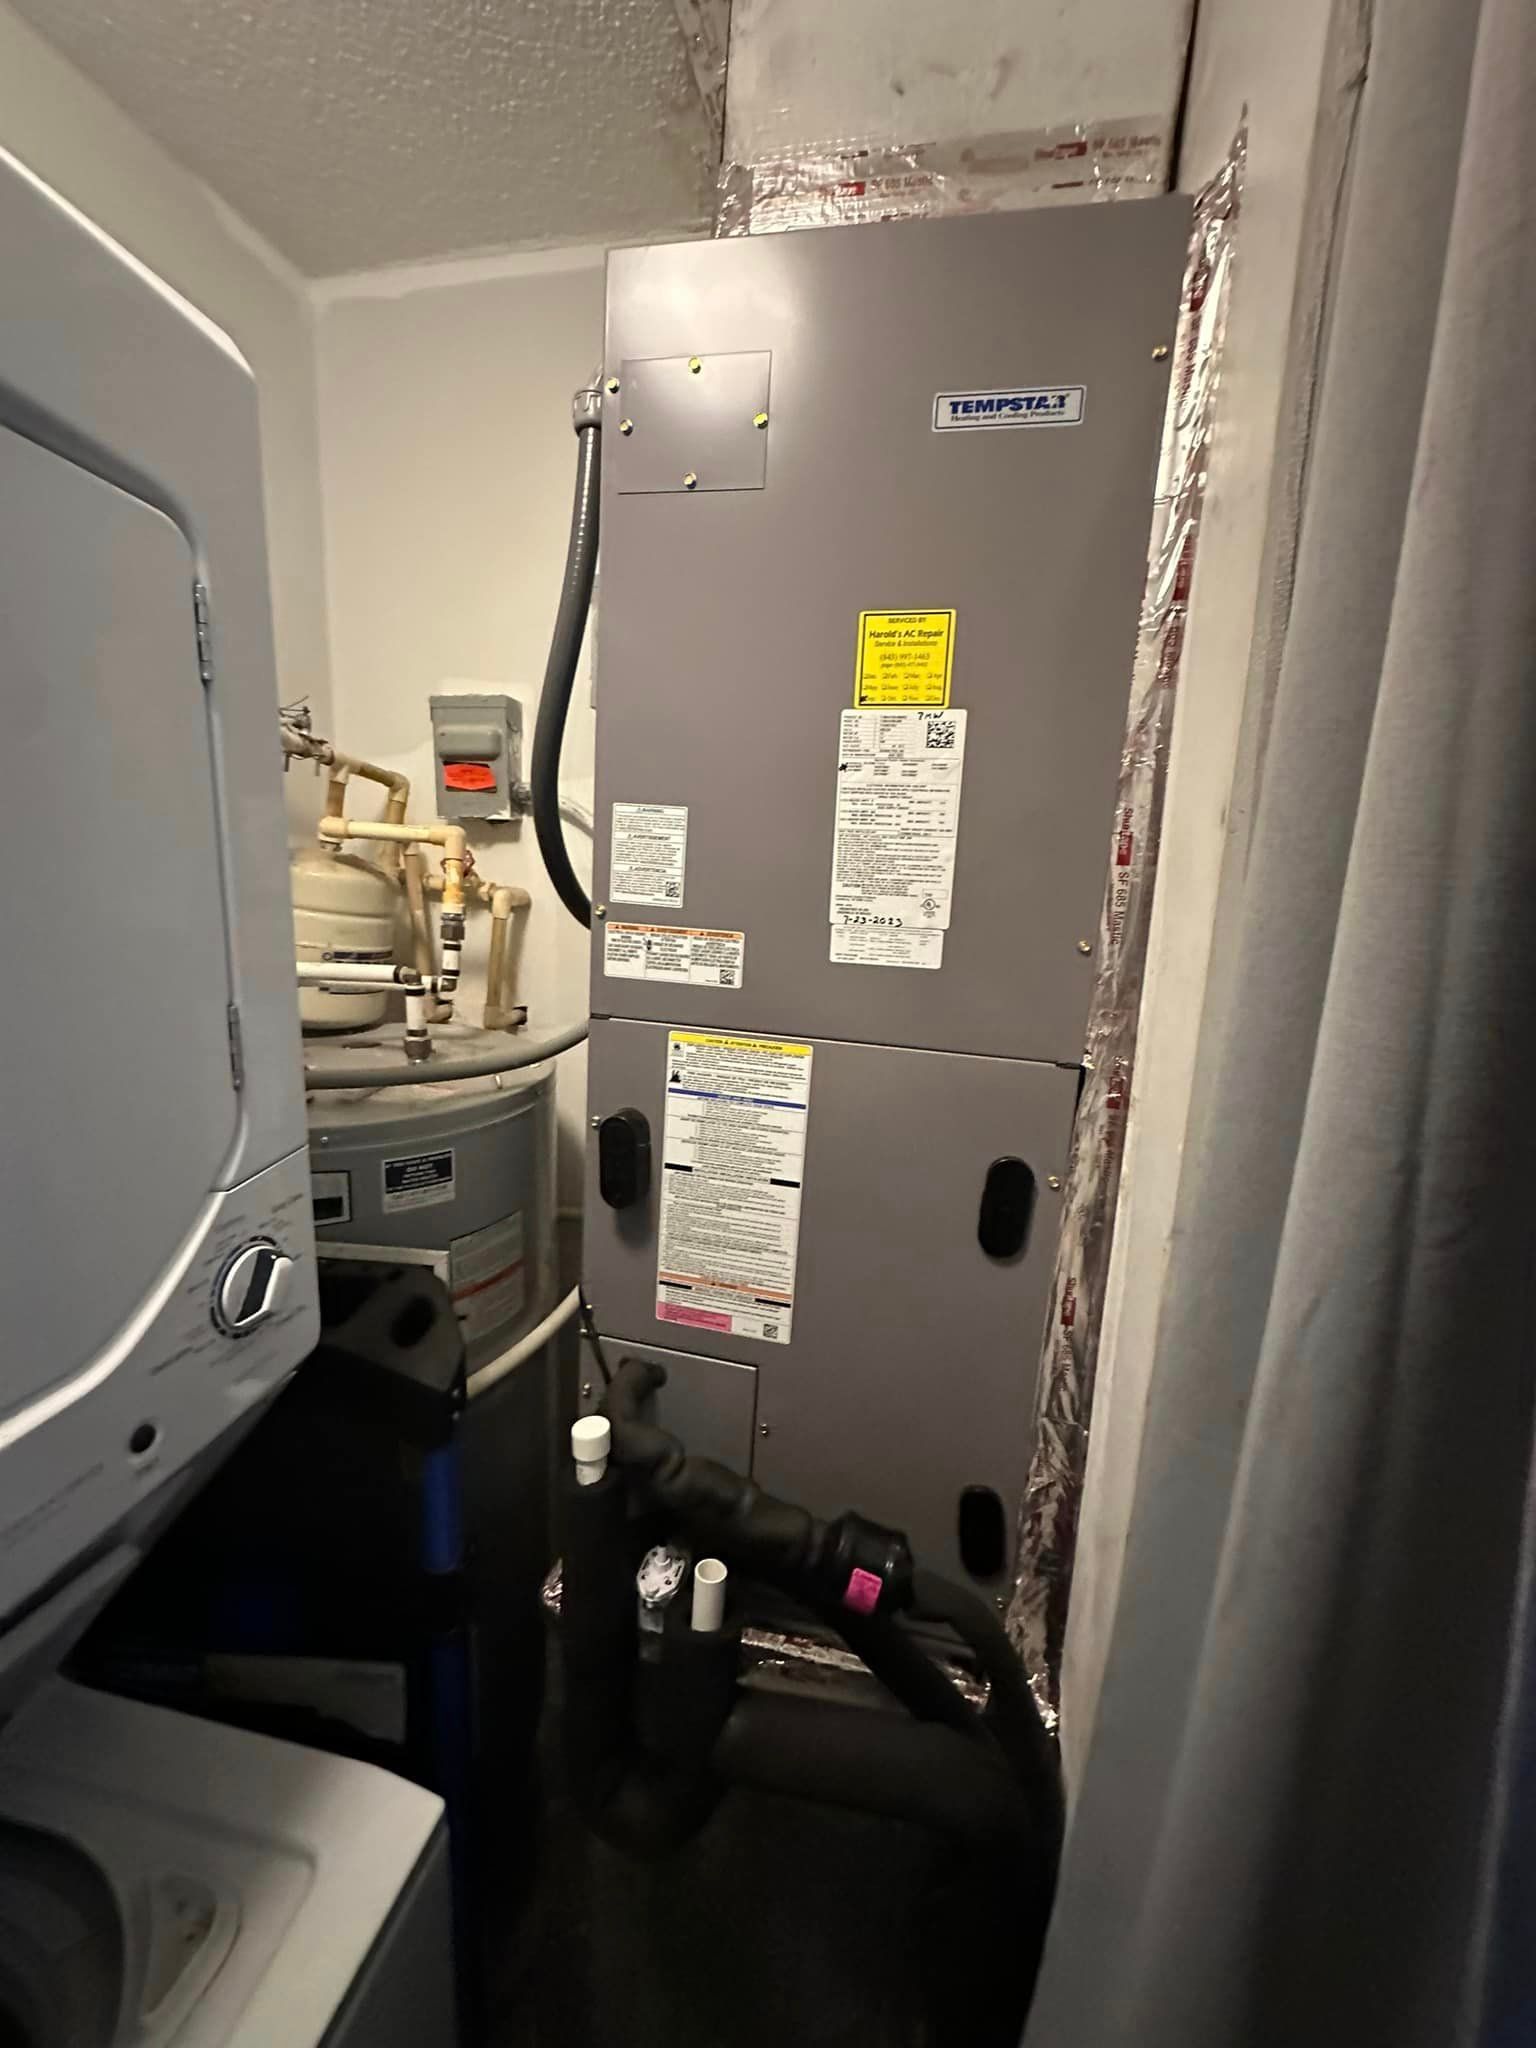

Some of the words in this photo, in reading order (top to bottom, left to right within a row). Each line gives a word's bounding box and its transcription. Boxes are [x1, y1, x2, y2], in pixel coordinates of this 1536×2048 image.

[949, 395, 1066, 414] TEMPSTAR
[869, 630, 902, 639] Harold's
[903, 630, 916, 638] AC
[918, 630, 945, 639] Repair
[1118, 871, 1128, 887] SF
[1115, 889, 1127, 907] 685
[843, 915, 903, 927] 7-23-2023
